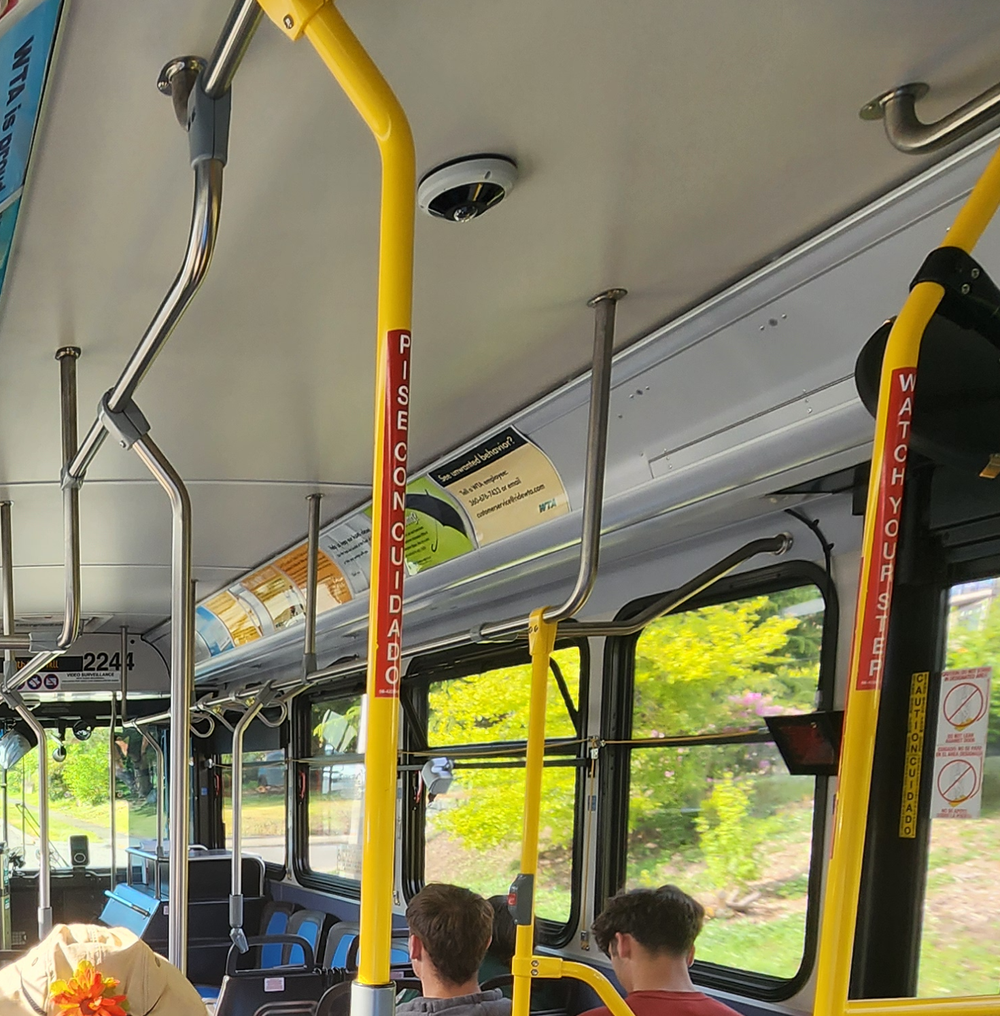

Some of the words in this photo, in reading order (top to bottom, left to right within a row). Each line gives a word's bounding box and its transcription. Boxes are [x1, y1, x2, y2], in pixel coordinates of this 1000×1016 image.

[7, 35, 35, 107] WTA
[2, 103, 22, 131] is
[397, 334, 411, 431] PISE
[477, 436, 515, 461] behavior?
[891, 373, 916, 486] WATCH
[393, 442, 408, 511] CON
[880, 496, 902, 582] YOUR
[385, 522, 405, 685] CUIDADO
[869, 593, 889, 677] STEP
[84, 652, 135, 671] 2244
[910, 674, 924, 752] CAUTION
[904, 757, 917, 835] CUIDADO
